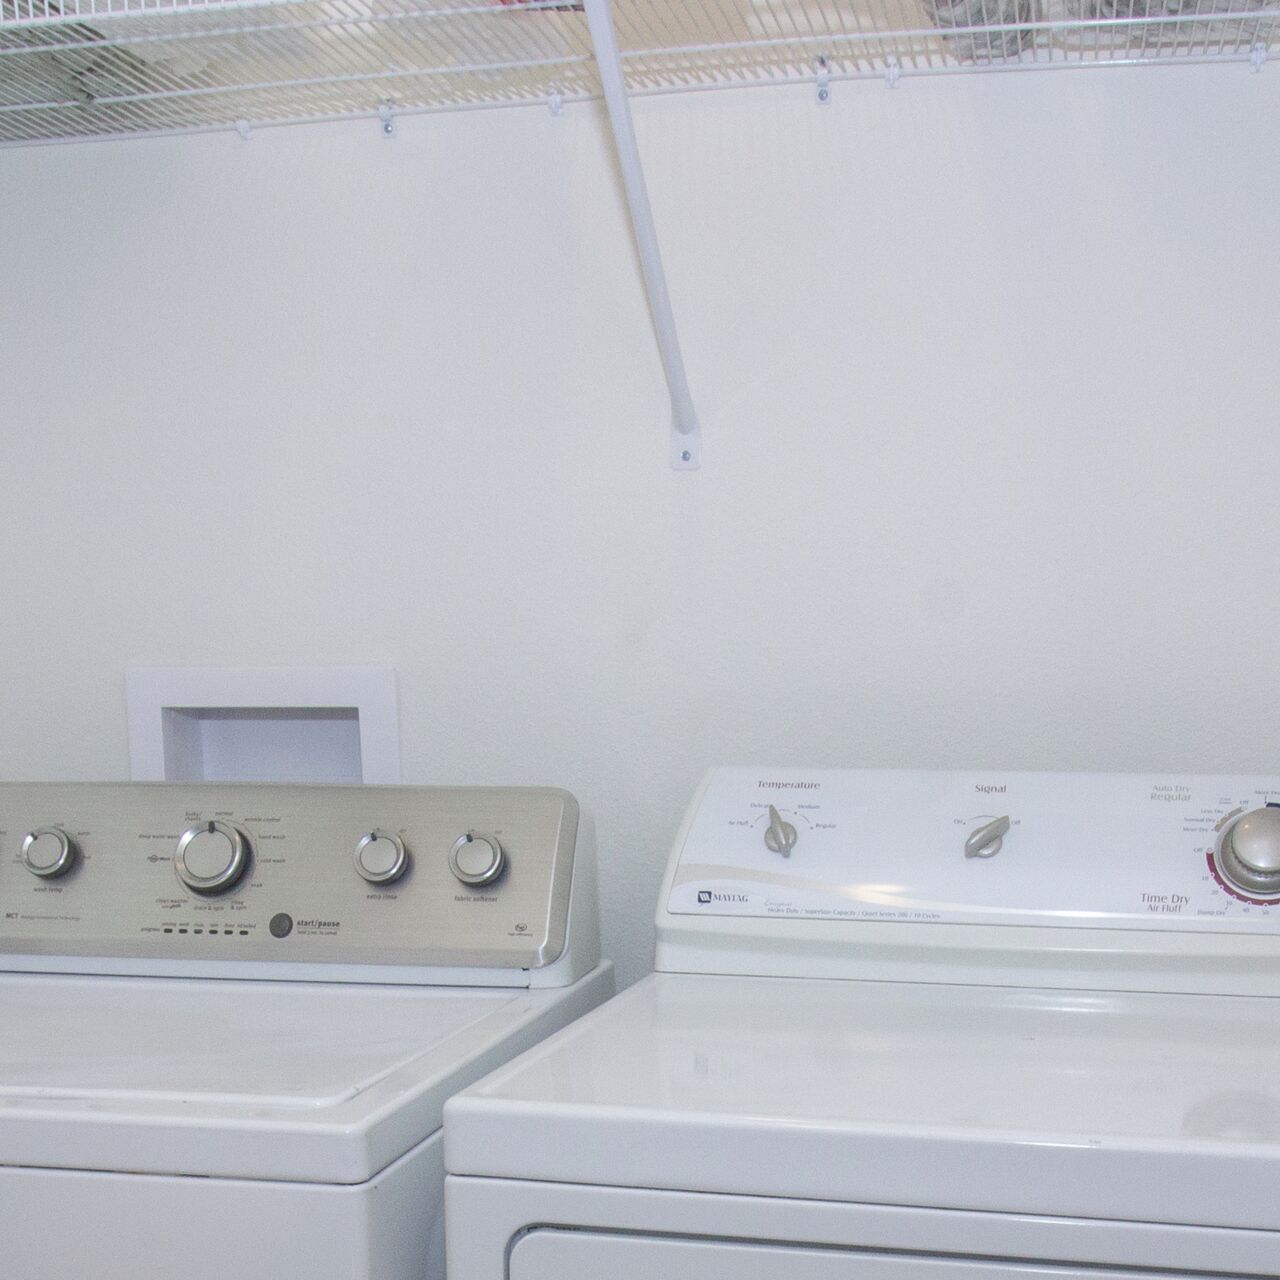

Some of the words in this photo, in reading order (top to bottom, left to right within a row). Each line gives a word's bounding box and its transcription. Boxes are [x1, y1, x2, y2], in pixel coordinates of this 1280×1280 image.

[758, 780, 821, 789] Temperature
[975, 784, 1007, 794] Signal
[1150, 793, 1191, 802] Regular
[713, 893, 749, 903] MAYTAG
[1141, 893, 1168, 903] Time
[1171, 894, 1190, 905] Dry
[1147, 904, 1159, 912] Air
[1161, 904, 1182, 913] Fluff
[297, 919, 340, 928] start/pause
